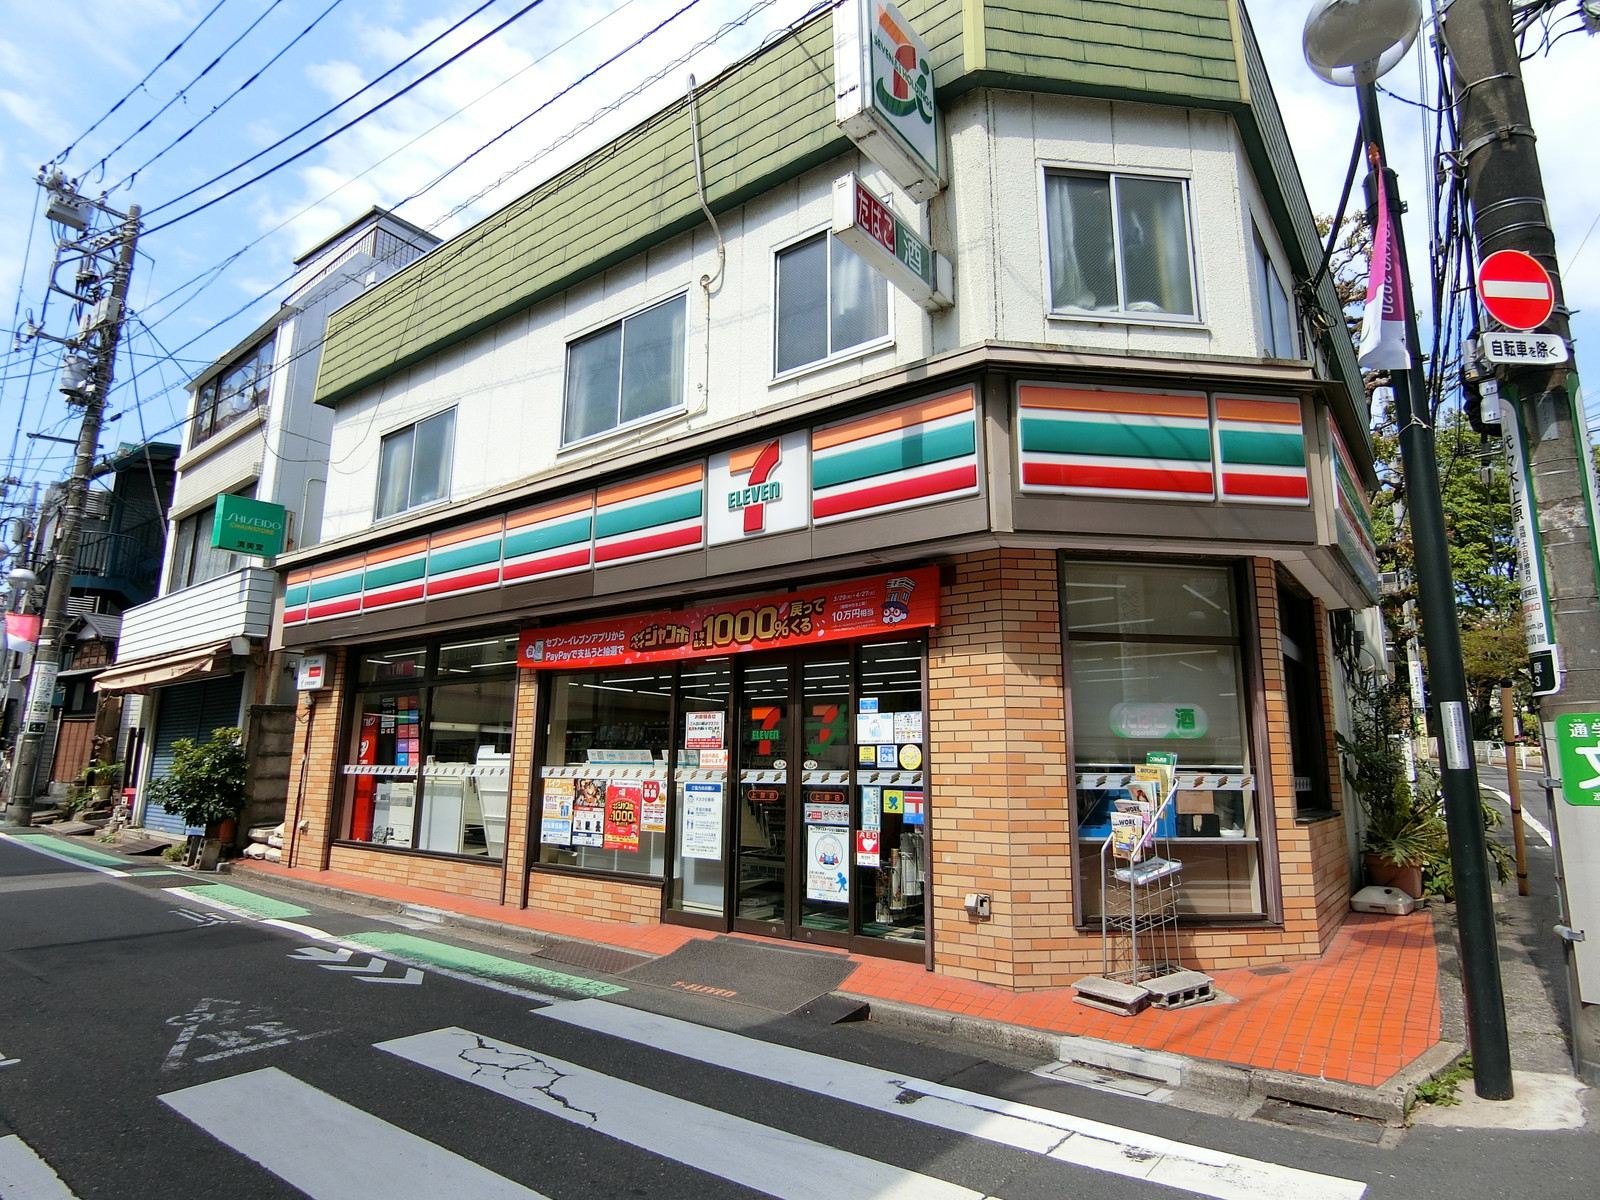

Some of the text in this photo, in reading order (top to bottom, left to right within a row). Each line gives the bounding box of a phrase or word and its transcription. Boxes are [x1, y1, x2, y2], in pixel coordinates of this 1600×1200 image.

[874, 35, 894, 65] SEVEN
[902, 69, 933, 111] HOLDINGS
[858, 189, 922, 276] たばこ 酒
[1382, 275, 1394, 314] 2020
[1492, 338, 1559, 359] 自転車を除く
[224, 512, 282, 531] SHISEIDO
[789, 597, 826, 617] 戻って
[832, 608, 874, 622] 10万円相当
[645, 624, 690, 646] ジャンボ
[790, 618, 813, 634] くる
[545, 630, 625, 648] セブン-イレブンアプリから
[545, 645, 625, 662] PayPayで支払うと抽選で
[386, 665, 405, 676] ATM
[1121, 707, 1168, 729] たばこ
[1175, 708, 1196, 730] 酒
[1118, 818, 1136, 826] WORK
